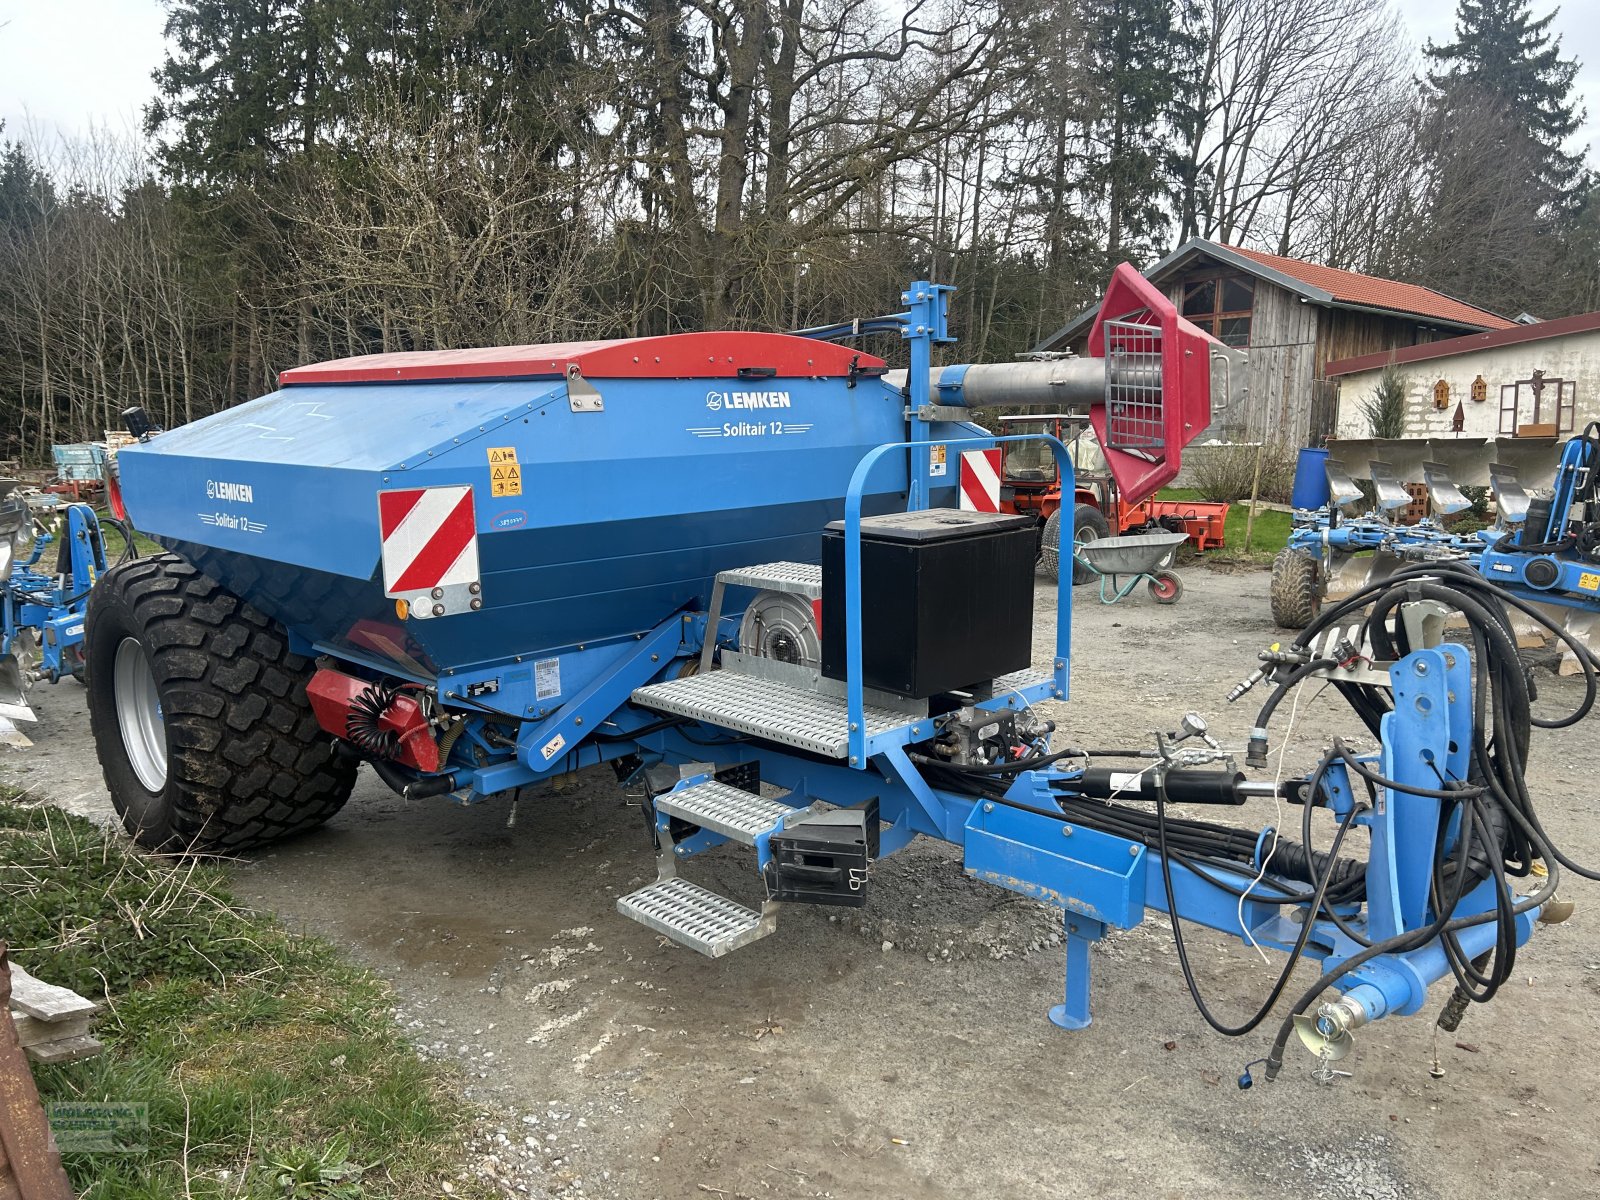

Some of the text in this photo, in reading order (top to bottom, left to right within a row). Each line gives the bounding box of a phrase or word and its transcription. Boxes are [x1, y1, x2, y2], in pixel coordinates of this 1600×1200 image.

[723, 391, 791, 411] LEMKEN
[723, 421, 783, 437] Solitair 12
[214, 481, 253, 503] LEMKEN
[215, 512, 248, 531] Solitair 12
